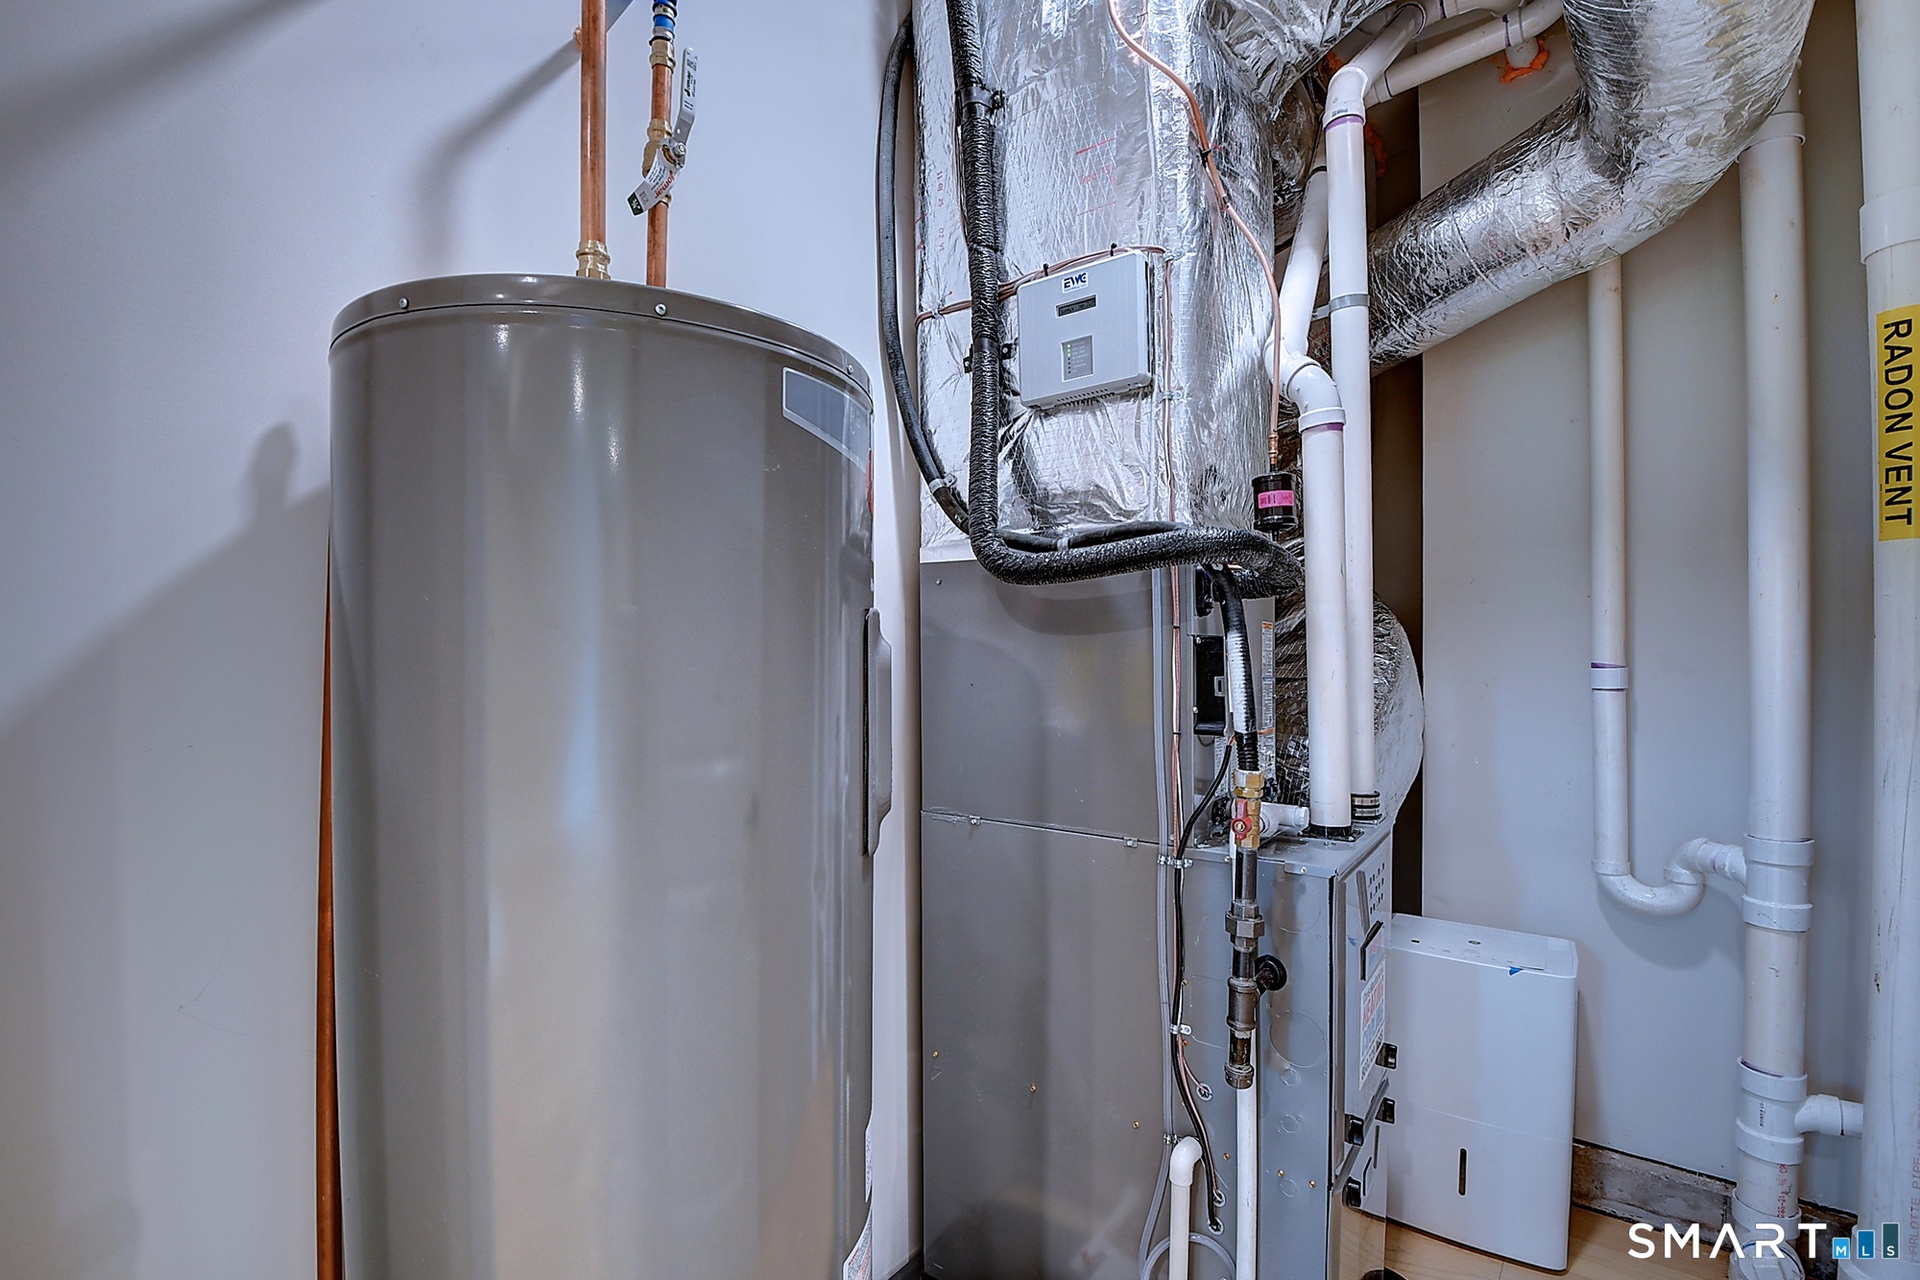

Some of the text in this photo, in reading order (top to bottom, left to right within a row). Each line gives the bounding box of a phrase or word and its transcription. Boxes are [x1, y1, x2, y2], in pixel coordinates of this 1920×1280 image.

[655, 169, 675, 199] Jomar
[1883, 318, 1914, 526] RADON VENT
